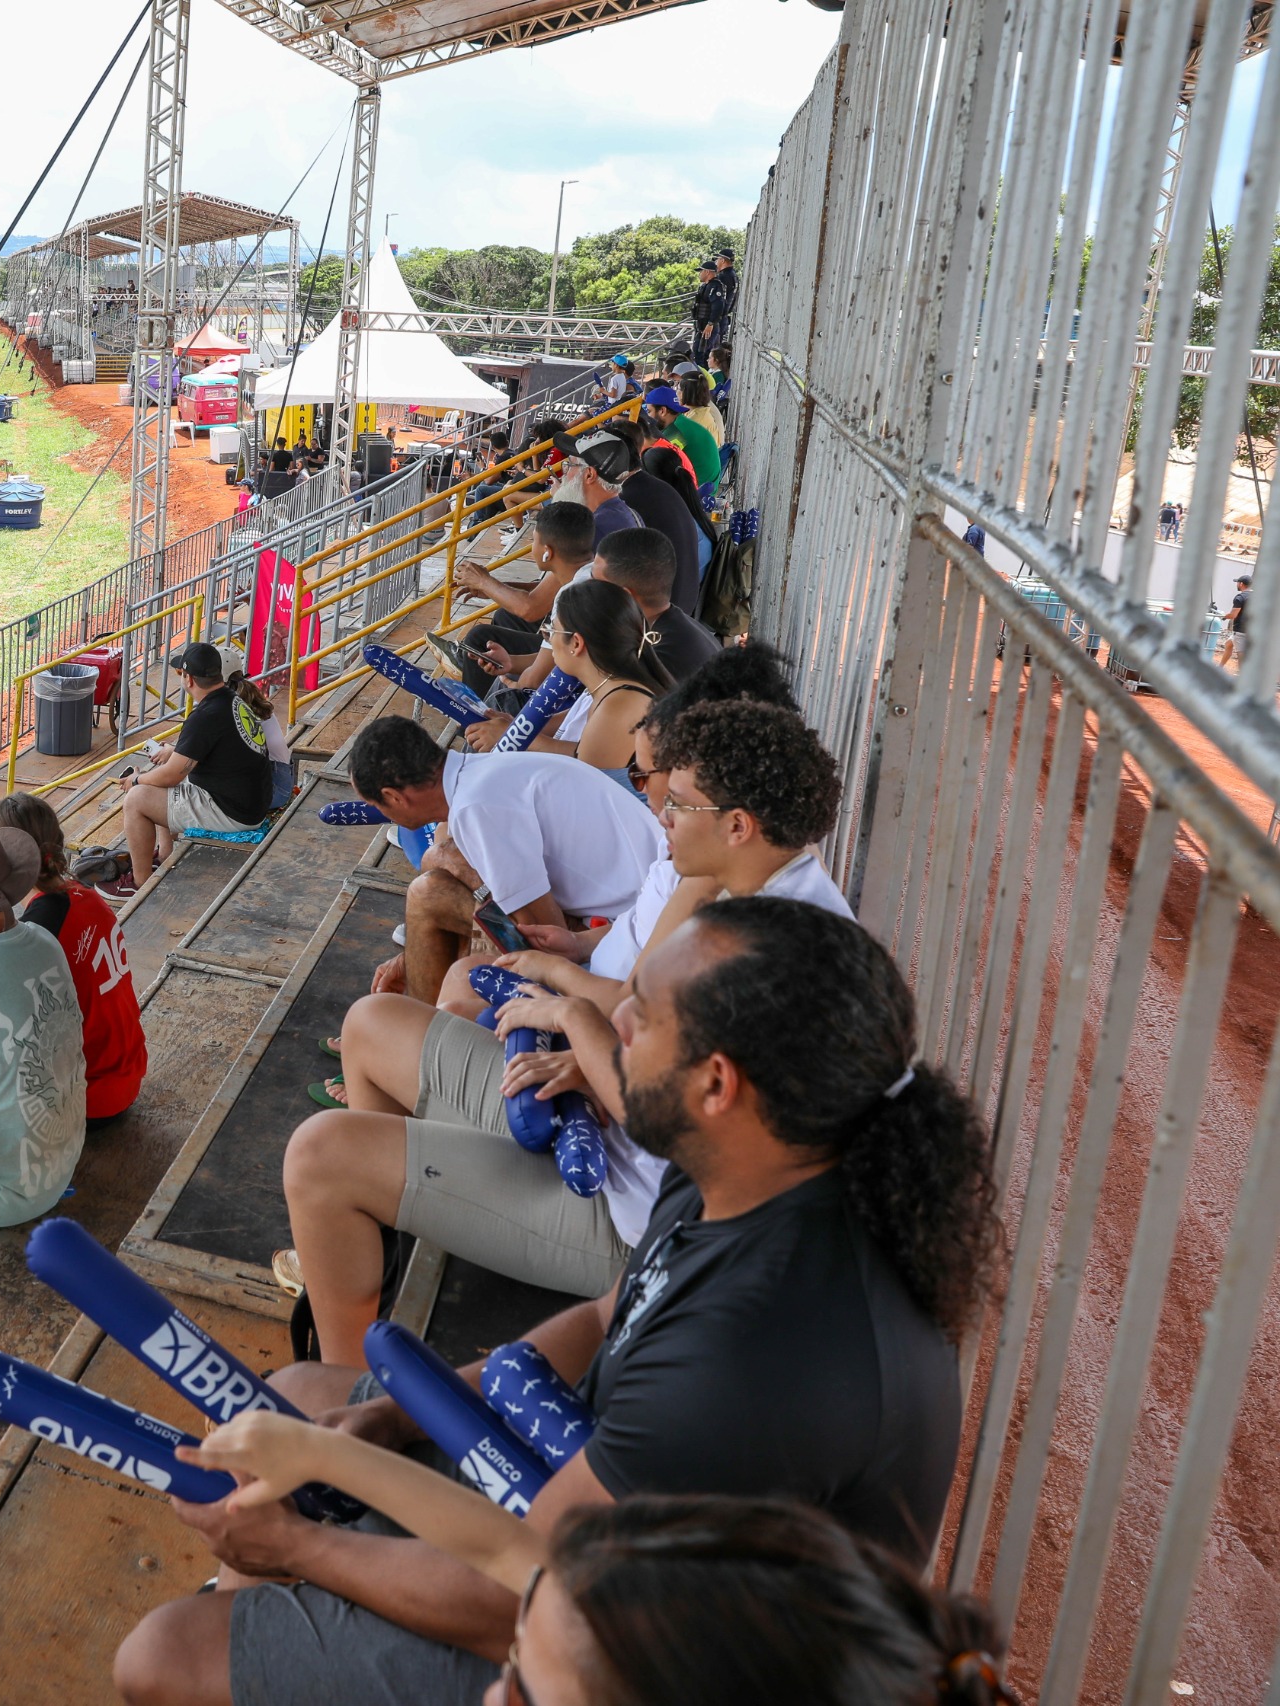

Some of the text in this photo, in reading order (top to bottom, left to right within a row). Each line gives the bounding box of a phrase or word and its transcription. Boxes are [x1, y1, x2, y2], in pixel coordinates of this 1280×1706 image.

[450, 701, 467, 715] banco
[499, 714, 534, 752] BRB
[92, 922, 130, 995] 16
[173, 1308, 211, 1344] banco
[134, 1416, 182, 1446] banco
[477, 1437, 522, 1483] banco
